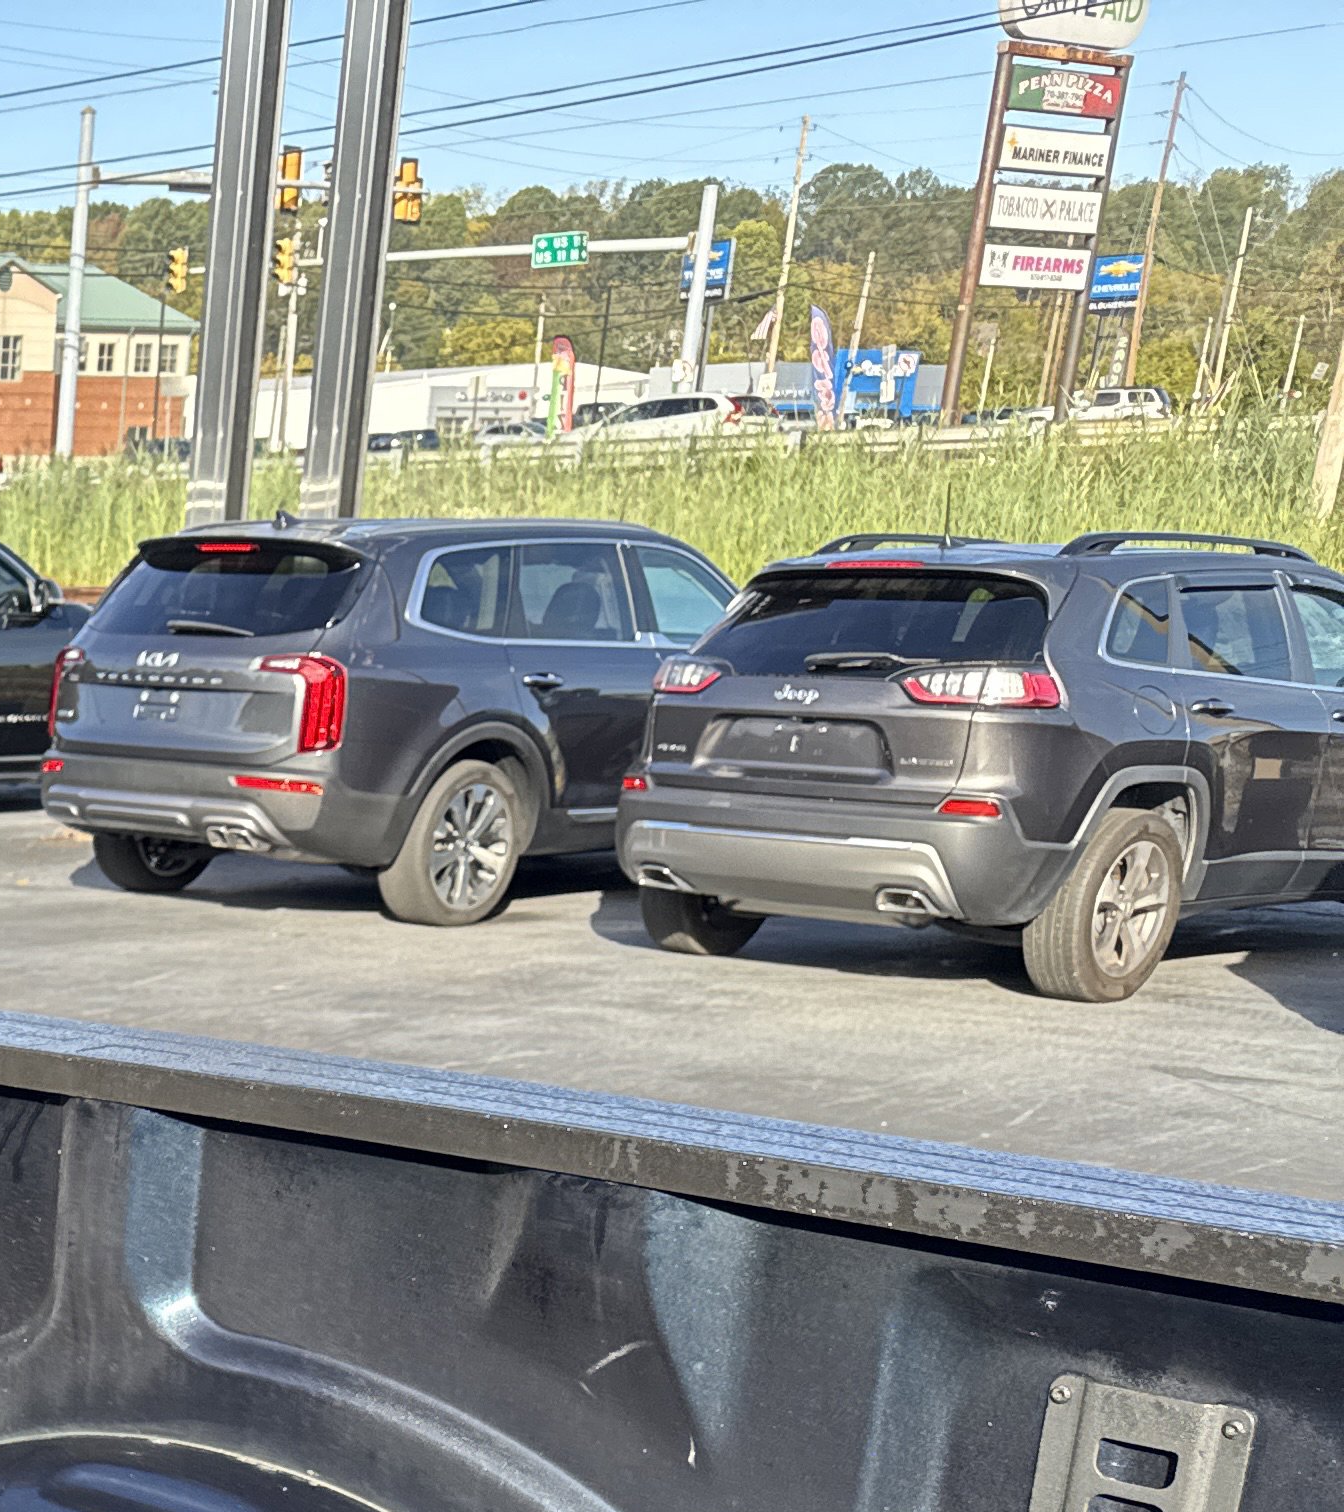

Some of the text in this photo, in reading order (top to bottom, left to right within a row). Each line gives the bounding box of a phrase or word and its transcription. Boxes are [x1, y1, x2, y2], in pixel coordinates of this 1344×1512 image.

[1100, 0, 1143, 23] AID
[1018, 73, 1113, 104] PENN PIZZA
[1012, 146, 1104, 167] MARINER FINANCE
[997, 194, 1038, 219] TOBACCO
[1058, 200, 1096, 222] PALACE
[1012, 255, 1084, 275] FIREARMS
[774, 684, 820, 704] Jeep
